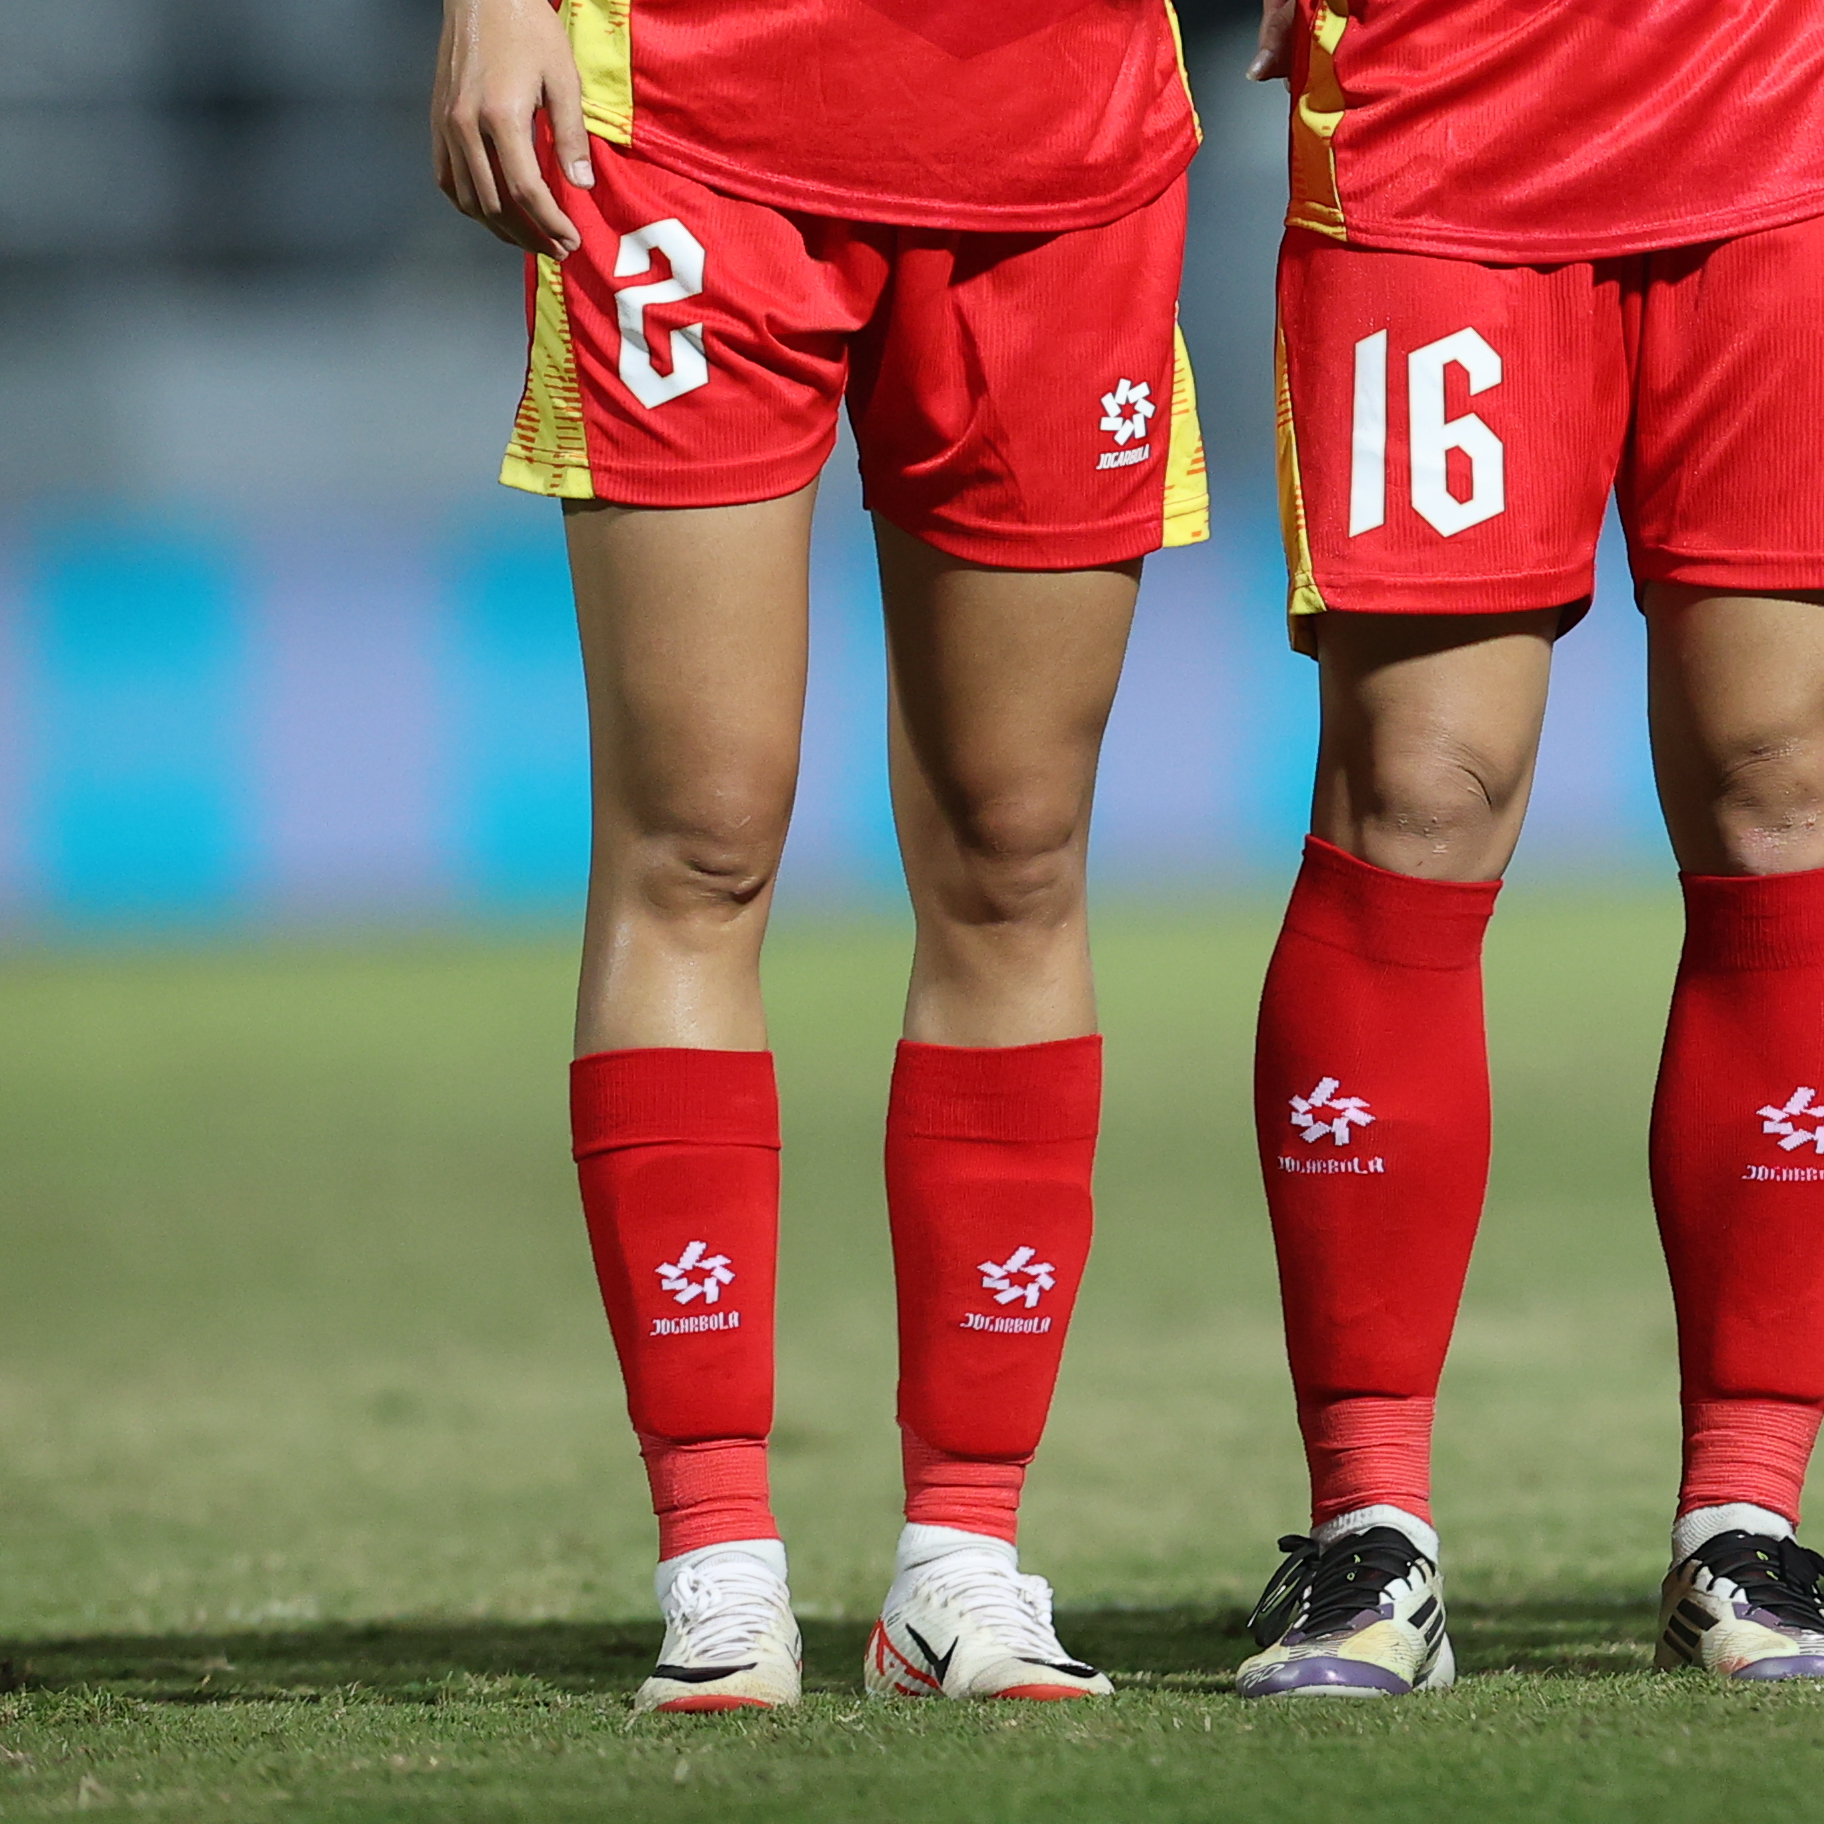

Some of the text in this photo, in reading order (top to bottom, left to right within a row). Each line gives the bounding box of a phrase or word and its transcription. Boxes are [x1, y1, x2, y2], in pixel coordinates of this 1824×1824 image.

[612, 216, 710, 411] 2
[1095, 444, 1150, 471] JOGARBOLA
[1347, 325, 1506, 539] 16
[649, 1310, 741, 1337] JOGARBOLA
